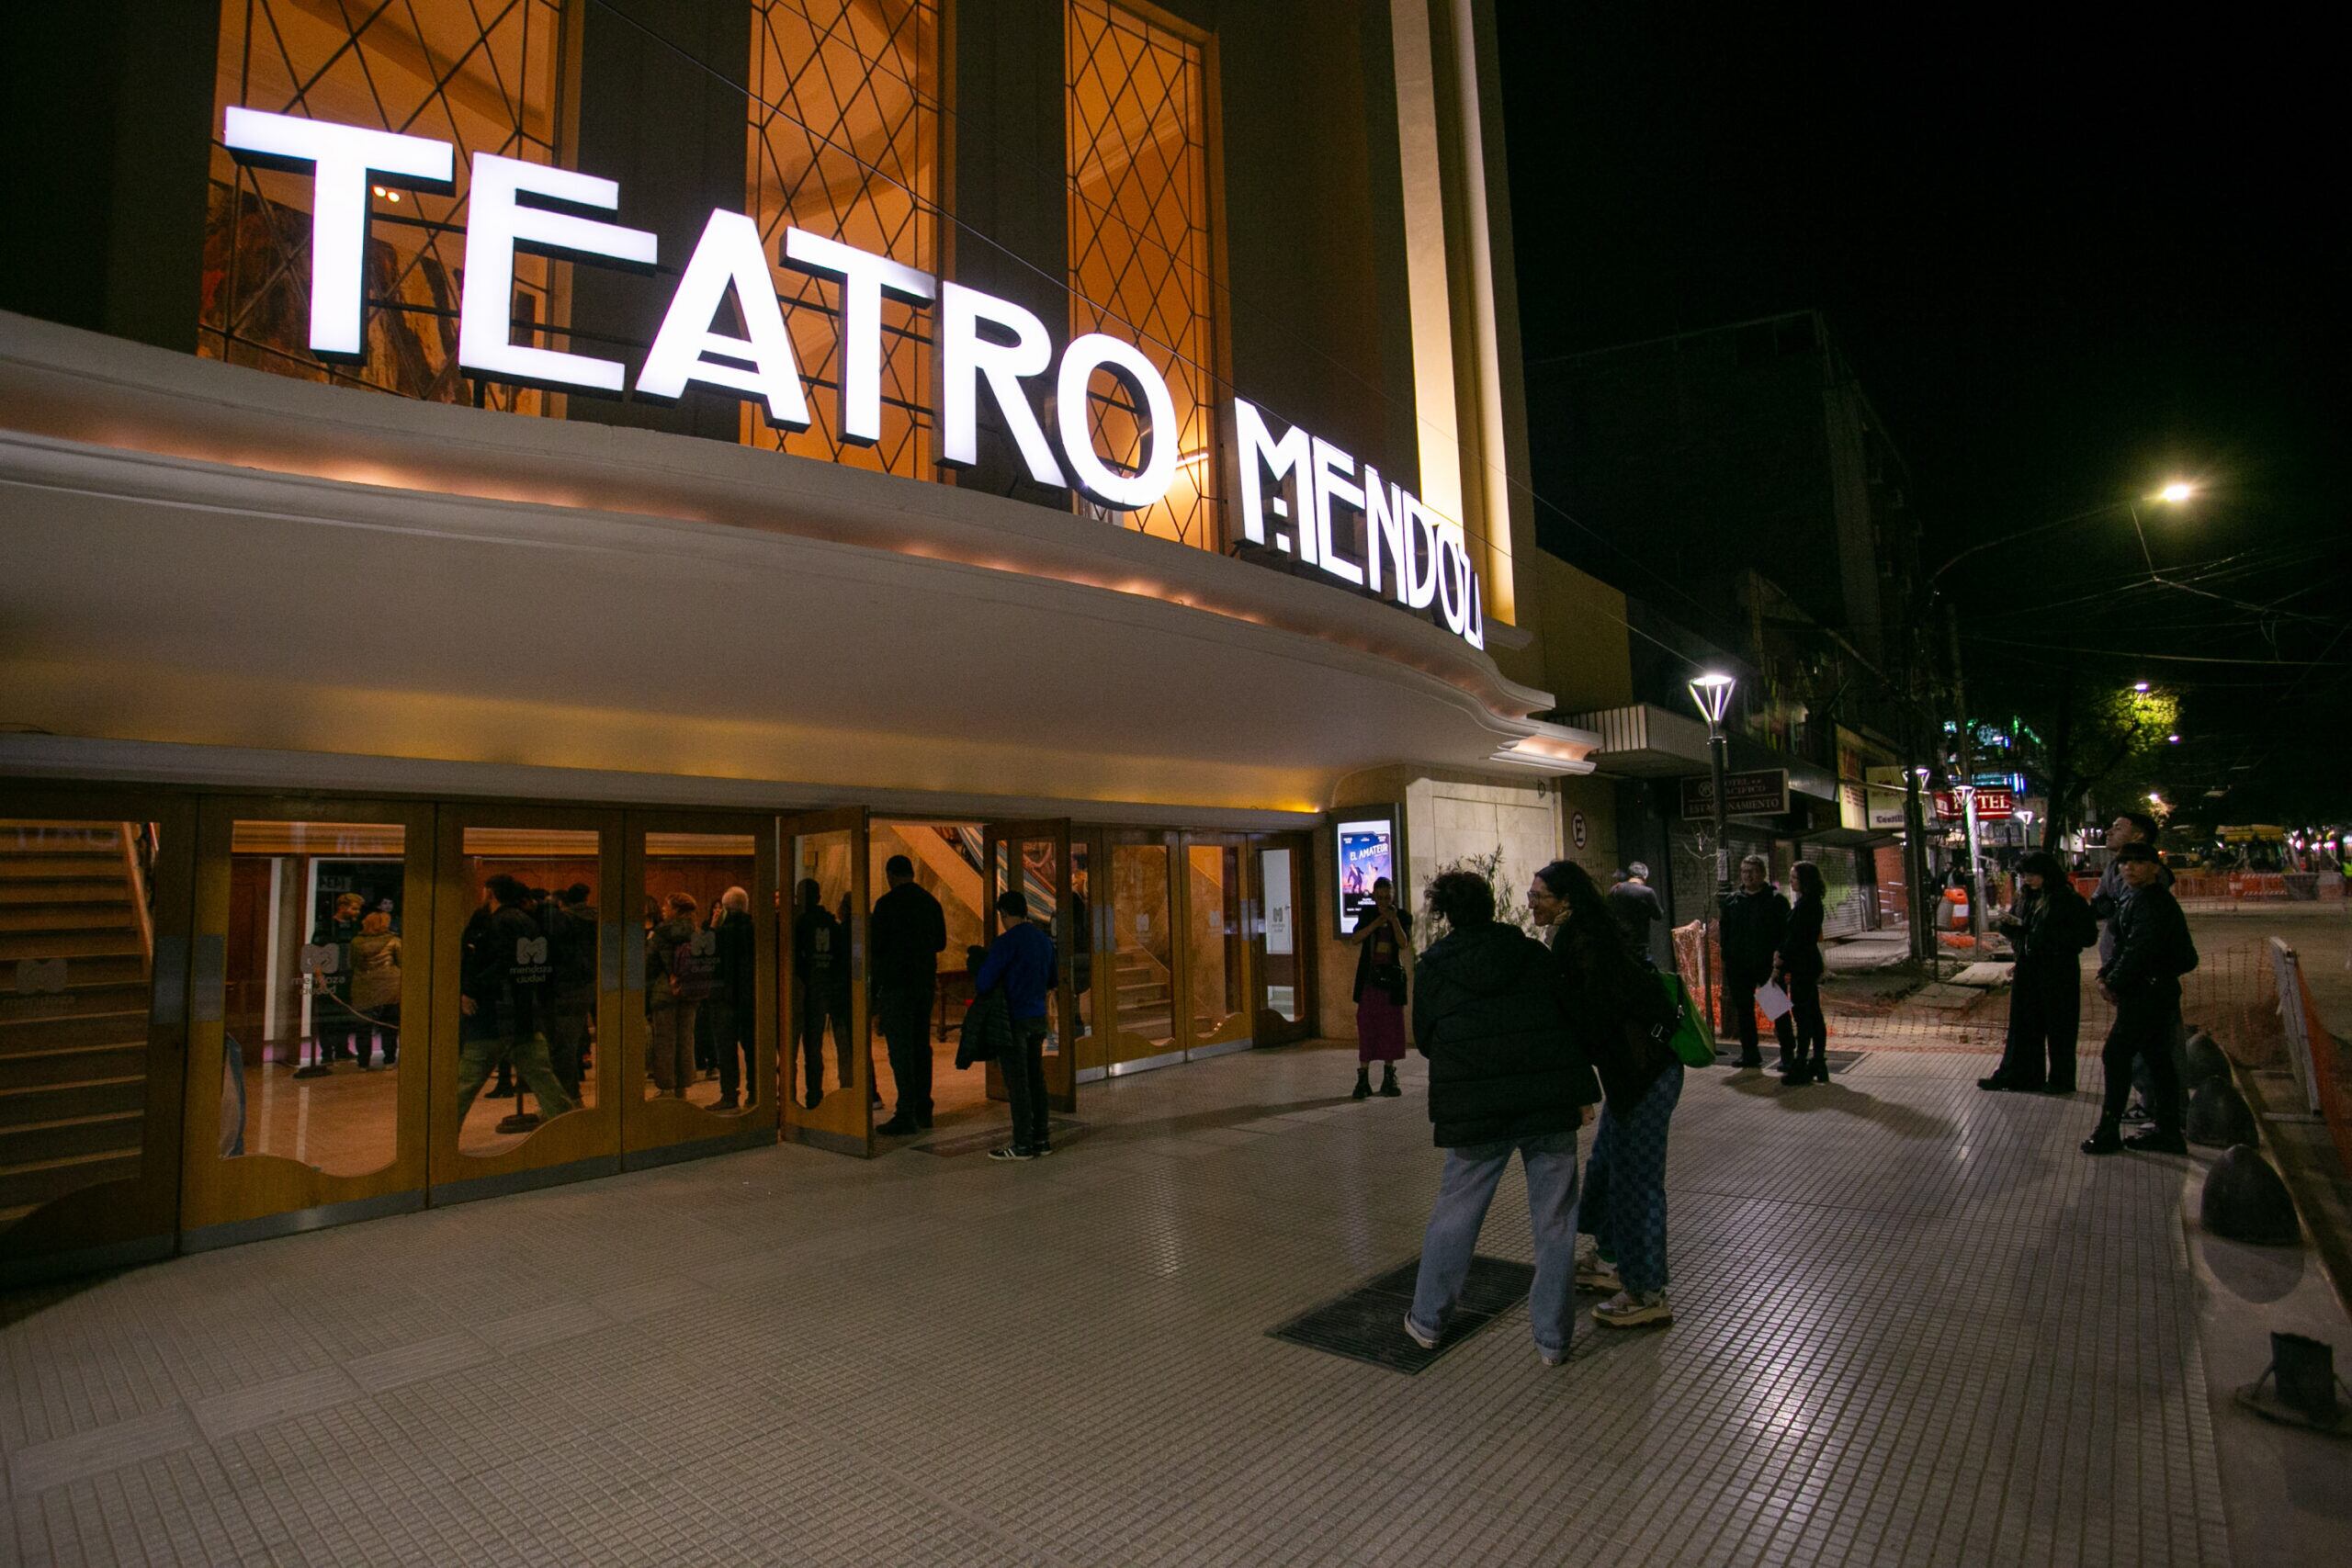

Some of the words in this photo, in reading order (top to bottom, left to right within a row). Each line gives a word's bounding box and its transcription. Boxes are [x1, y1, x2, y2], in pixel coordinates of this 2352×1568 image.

[224, 105, 1180, 513] TEATRO
[1350, 851, 1358, 862] EL
[1359, 842, 1389, 860] AMATEUR
